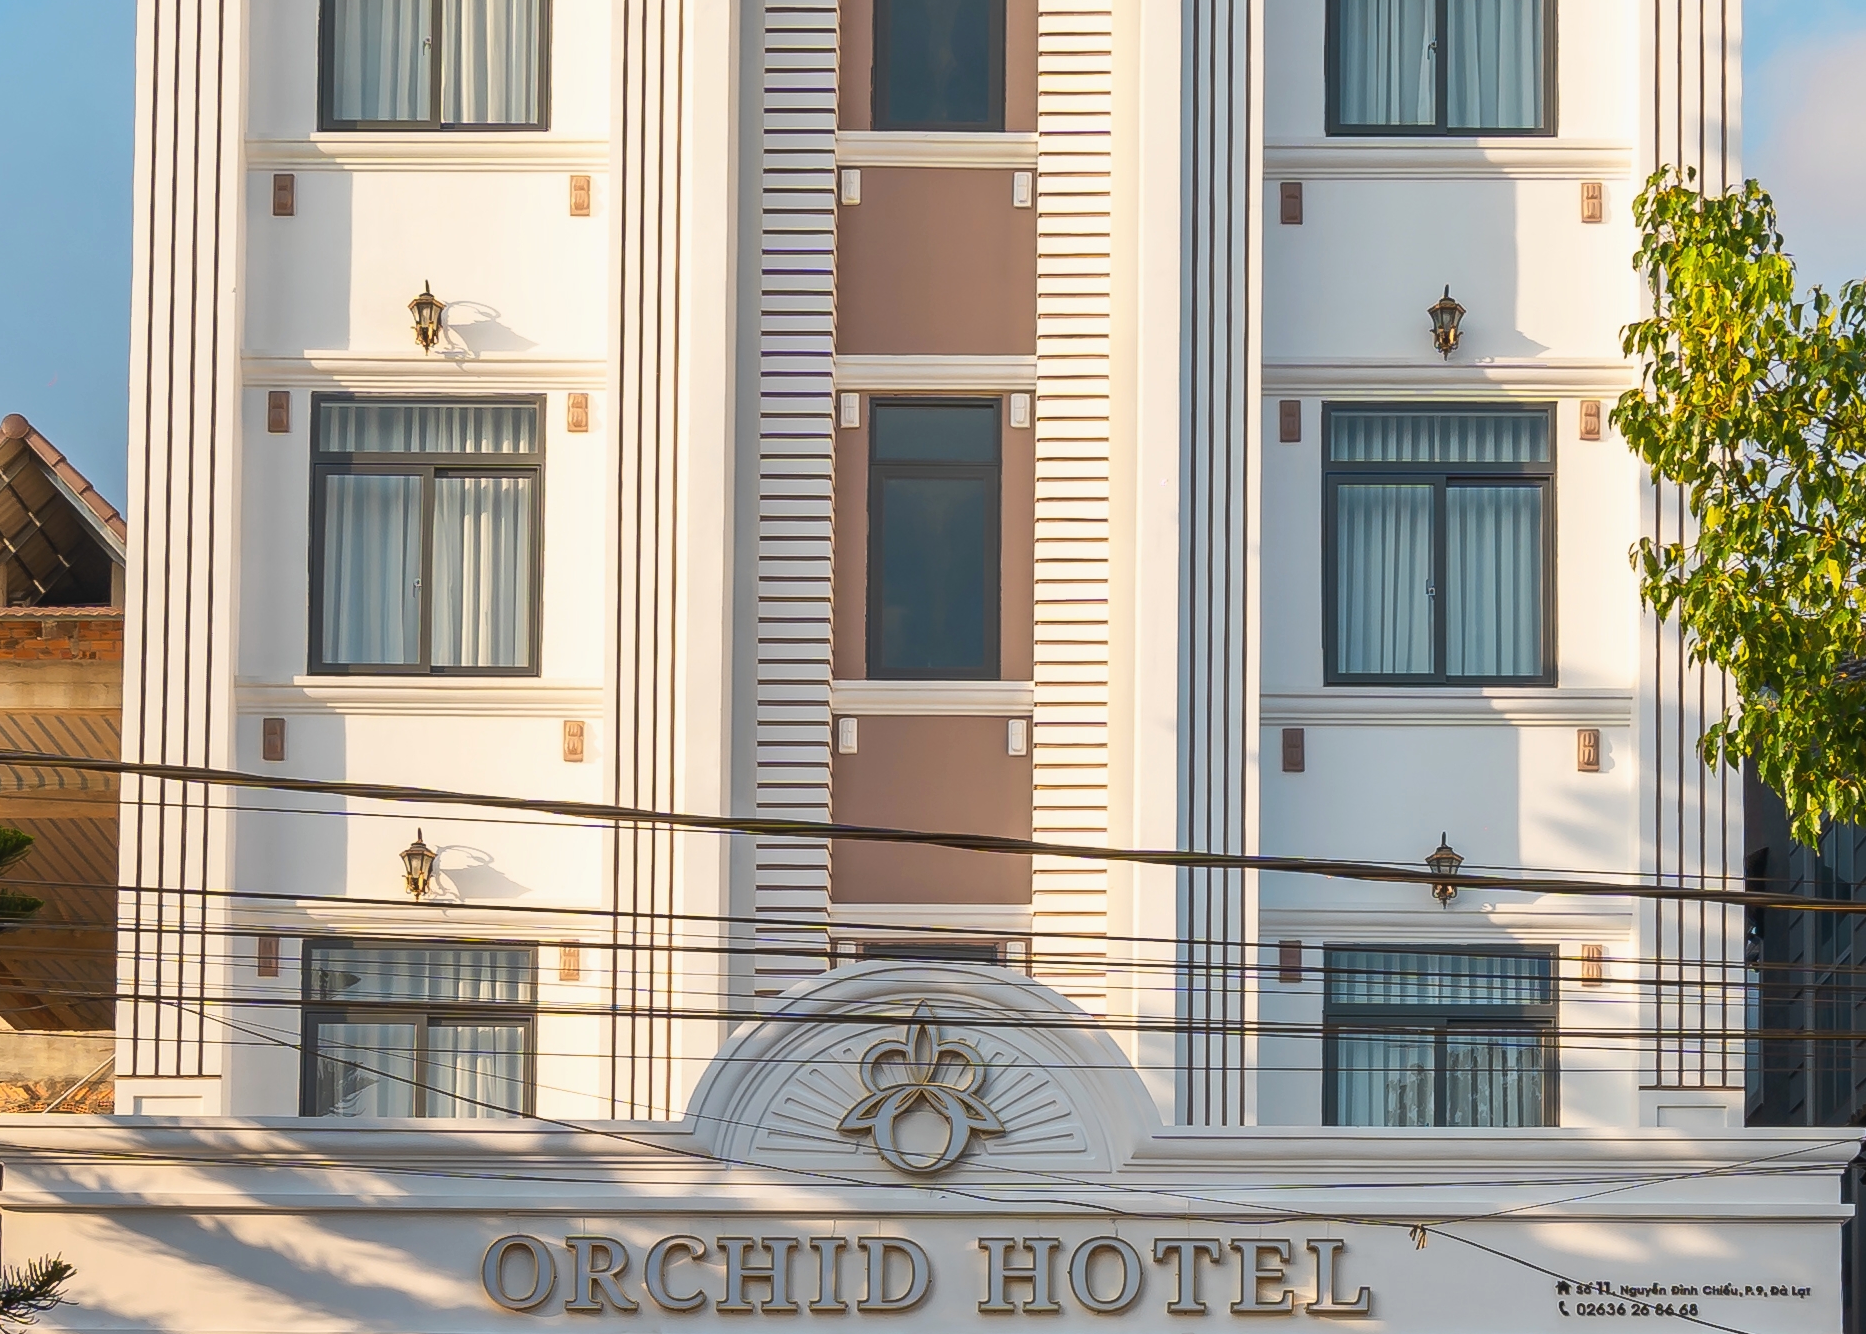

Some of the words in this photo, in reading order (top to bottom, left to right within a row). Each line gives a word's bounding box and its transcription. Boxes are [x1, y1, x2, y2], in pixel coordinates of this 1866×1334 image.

[480, 1233, 933, 1314] ORCHID
[976, 1235, 1372, 1315] HOTEL
[1671, 1284, 1699, 1296] Đình
[1770, 1285, 1789, 1297] Đà
[1791, 1285, 1811, 1299] Lạt
[1576, 1302, 1627, 1316] 02636
[1631, 1302, 1650, 1316] 26
[1654, 1303, 1674, 1316] 86
[1678, 1303, 1699, 1317] 68
